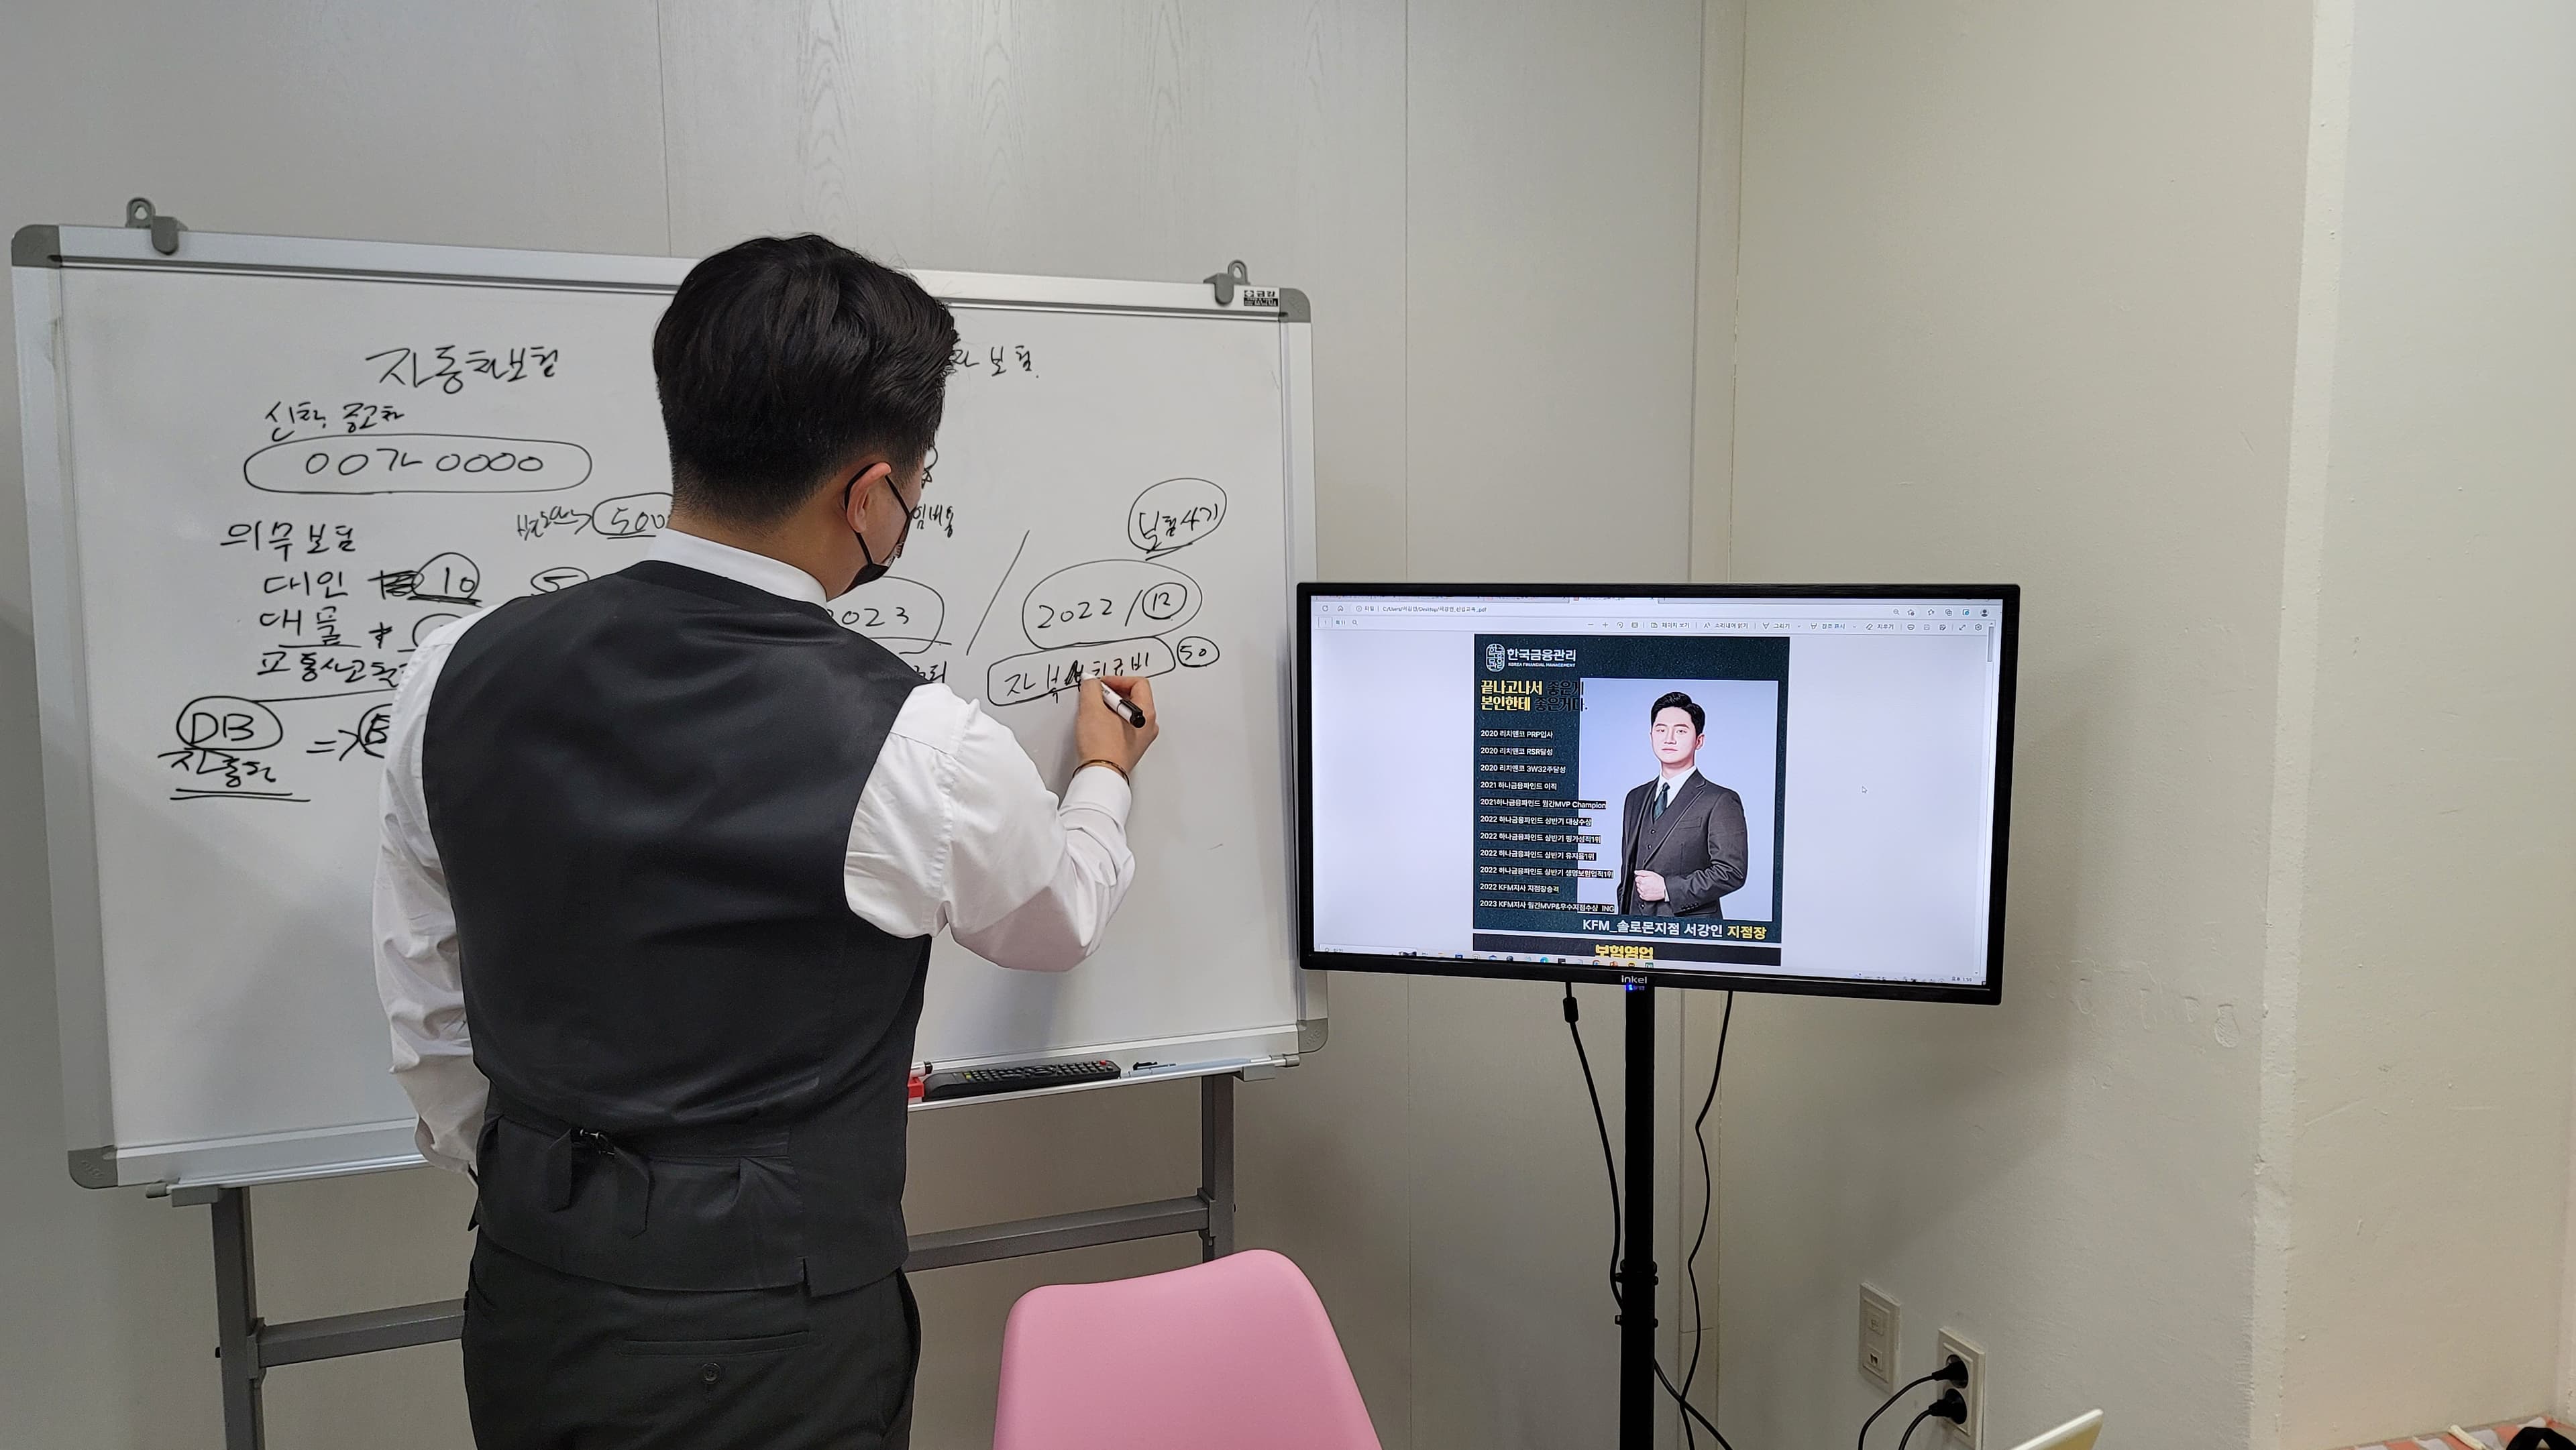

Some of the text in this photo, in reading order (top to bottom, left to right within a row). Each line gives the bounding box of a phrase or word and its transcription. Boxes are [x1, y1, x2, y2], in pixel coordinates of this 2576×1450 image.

[264, 571, 348, 599] 대인
[443, 567, 476, 594] 10
[1179, 645, 1207, 661] 50
[1507, 649, 1576, 661] 한국금융관리
[1481, 680, 1542, 695] 끝나고나서
[1481, 696, 1530, 711] 본인한테
[191, 712, 255, 744] DB
[1572, 801, 1606, 810] Champion
[1545, 817, 1564, 825] 상반기
[1545, 834, 1564, 842] 상반기
[1499, 850, 1543, 858] 하나금융파인드
[1499, 867, 1543, 875] 하나금융파인드
[1544, 868, 1564, 876] 상반기
[1499, 883, 1526, 891] KFM지사
[1582, 919, 1767, 940] KFM_솔로몬지점 서강인 지점장
[1595, 944, 1654, 960] 보험영업
[1621, 974, 1648, 984] inkel
